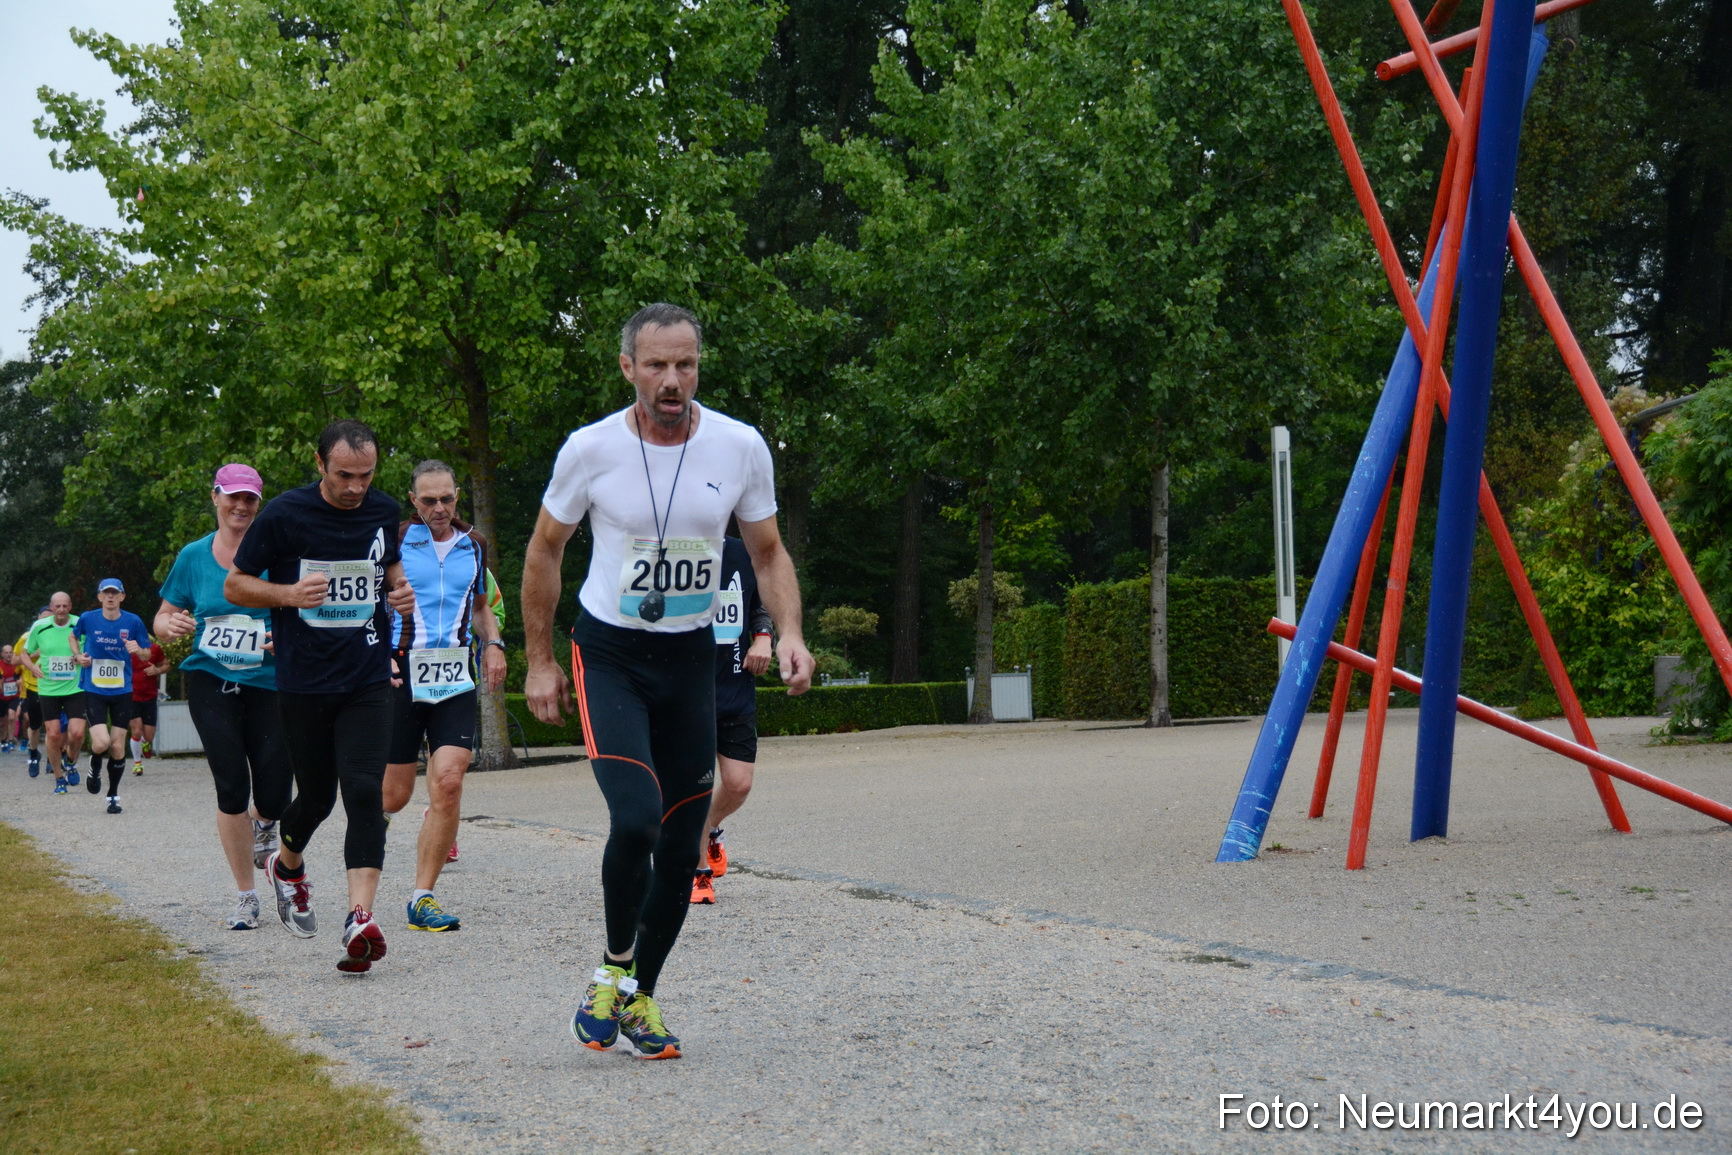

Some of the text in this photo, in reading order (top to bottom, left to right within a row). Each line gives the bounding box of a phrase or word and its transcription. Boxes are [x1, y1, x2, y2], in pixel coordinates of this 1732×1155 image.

[668, 540, 710, 551] BOCK
[335, 563, 369, 571] BOCK
[631, 559, 713, 592] 2005
[327, 576, 368, 602] 458
[317, 608, 357, 618] Andreas
[716, 604, 738, 623] 09
[208, 626, 258, 651] 2571
[216, 653, 245, 664] Sibylle
[52, 662, 74, 671] 2513
[99, 666, 118, 677] 600
[417, 661, 465, 683] 2752
[428, 687, 459, 697] Thomas
